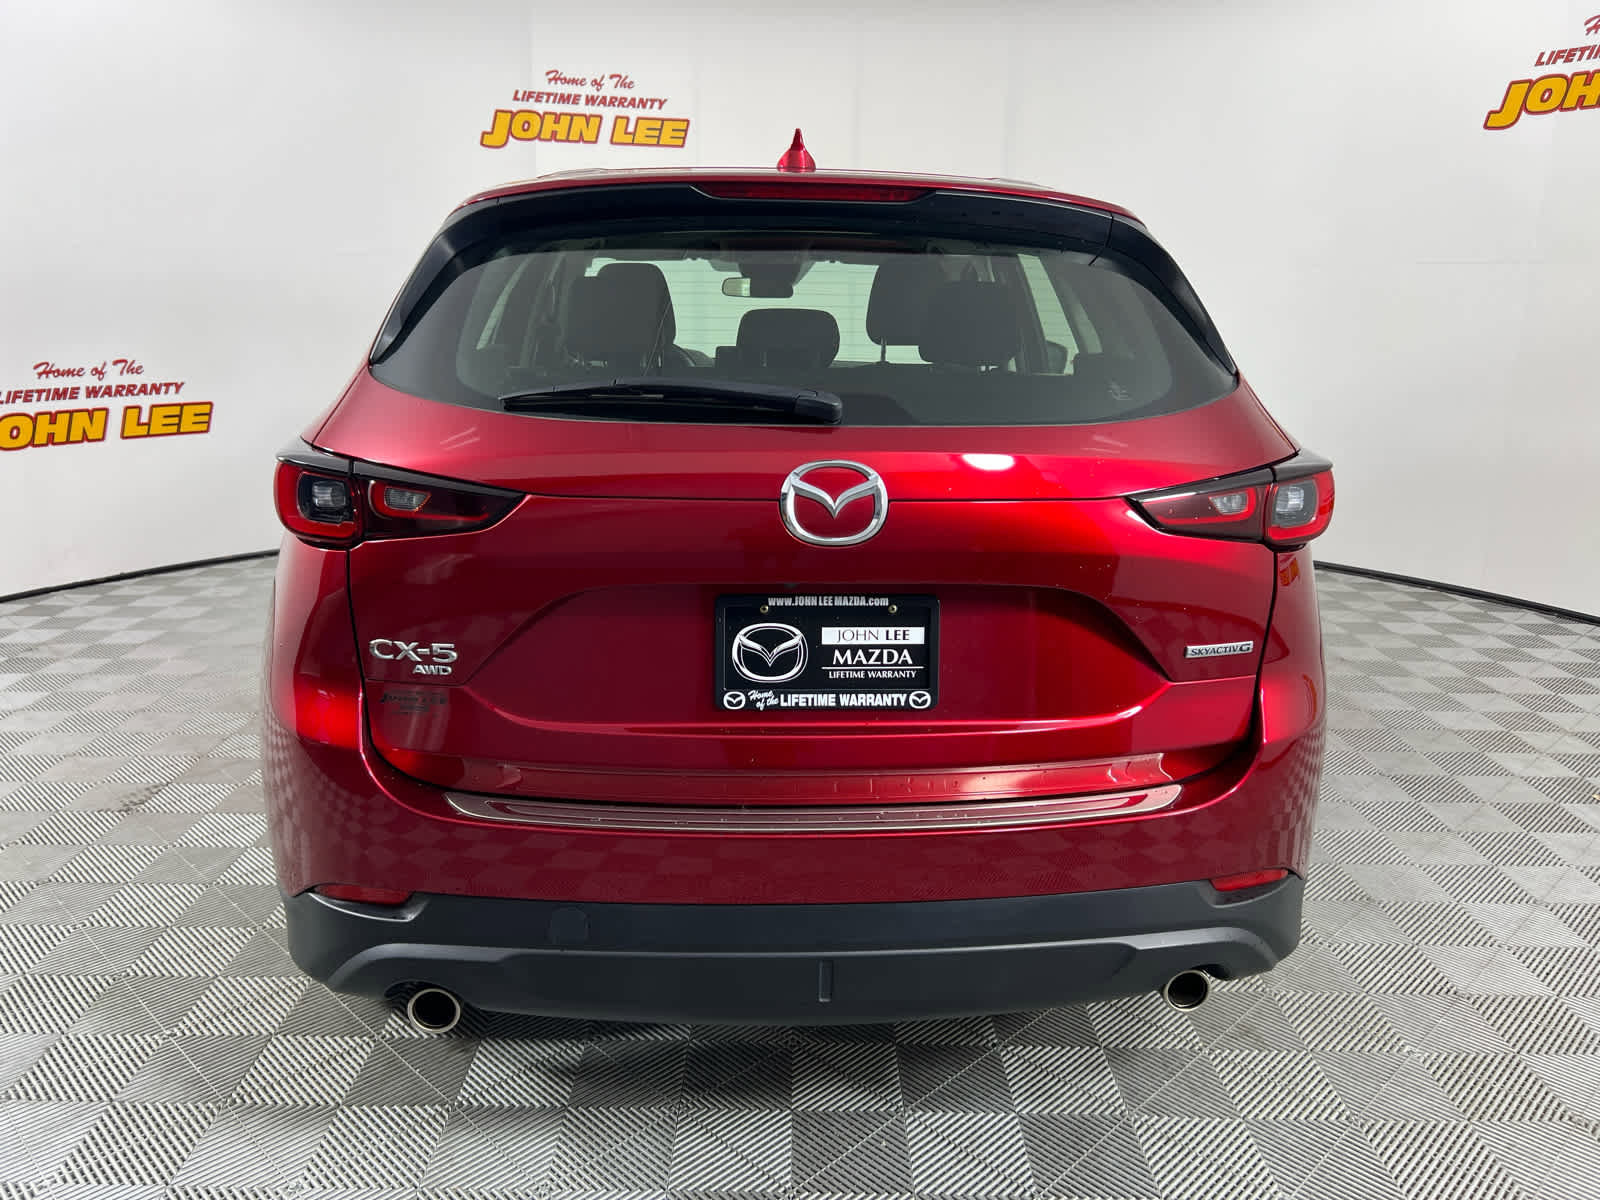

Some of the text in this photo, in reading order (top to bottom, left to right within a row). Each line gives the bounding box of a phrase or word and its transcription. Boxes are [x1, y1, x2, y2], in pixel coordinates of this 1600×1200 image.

[545, 69, 635, 92] Home of The
[512, 90, 668, 110] LIFETIME WARRANTY
[480, 109, 690, 149] JOHN LEE
[33, 358, 145, 381] Home of The
[85, 381, 185, 399] WARRANTY
[120, 401, 214, 440] LEE
[836, 629, 910, 643] JOHN LEE
[369, 638, 458, 663] CX-5
[832, 649, 913, 665] MAZDA
[412, 664, 453, 675] AWD
[828, 671, 917, 679] LIFETIME WARRANTY
[747, 690, 774, 700] Home
[780, 694, 836, 707] LIFETIME
[839, 694, 907, 707] WARRANTY
